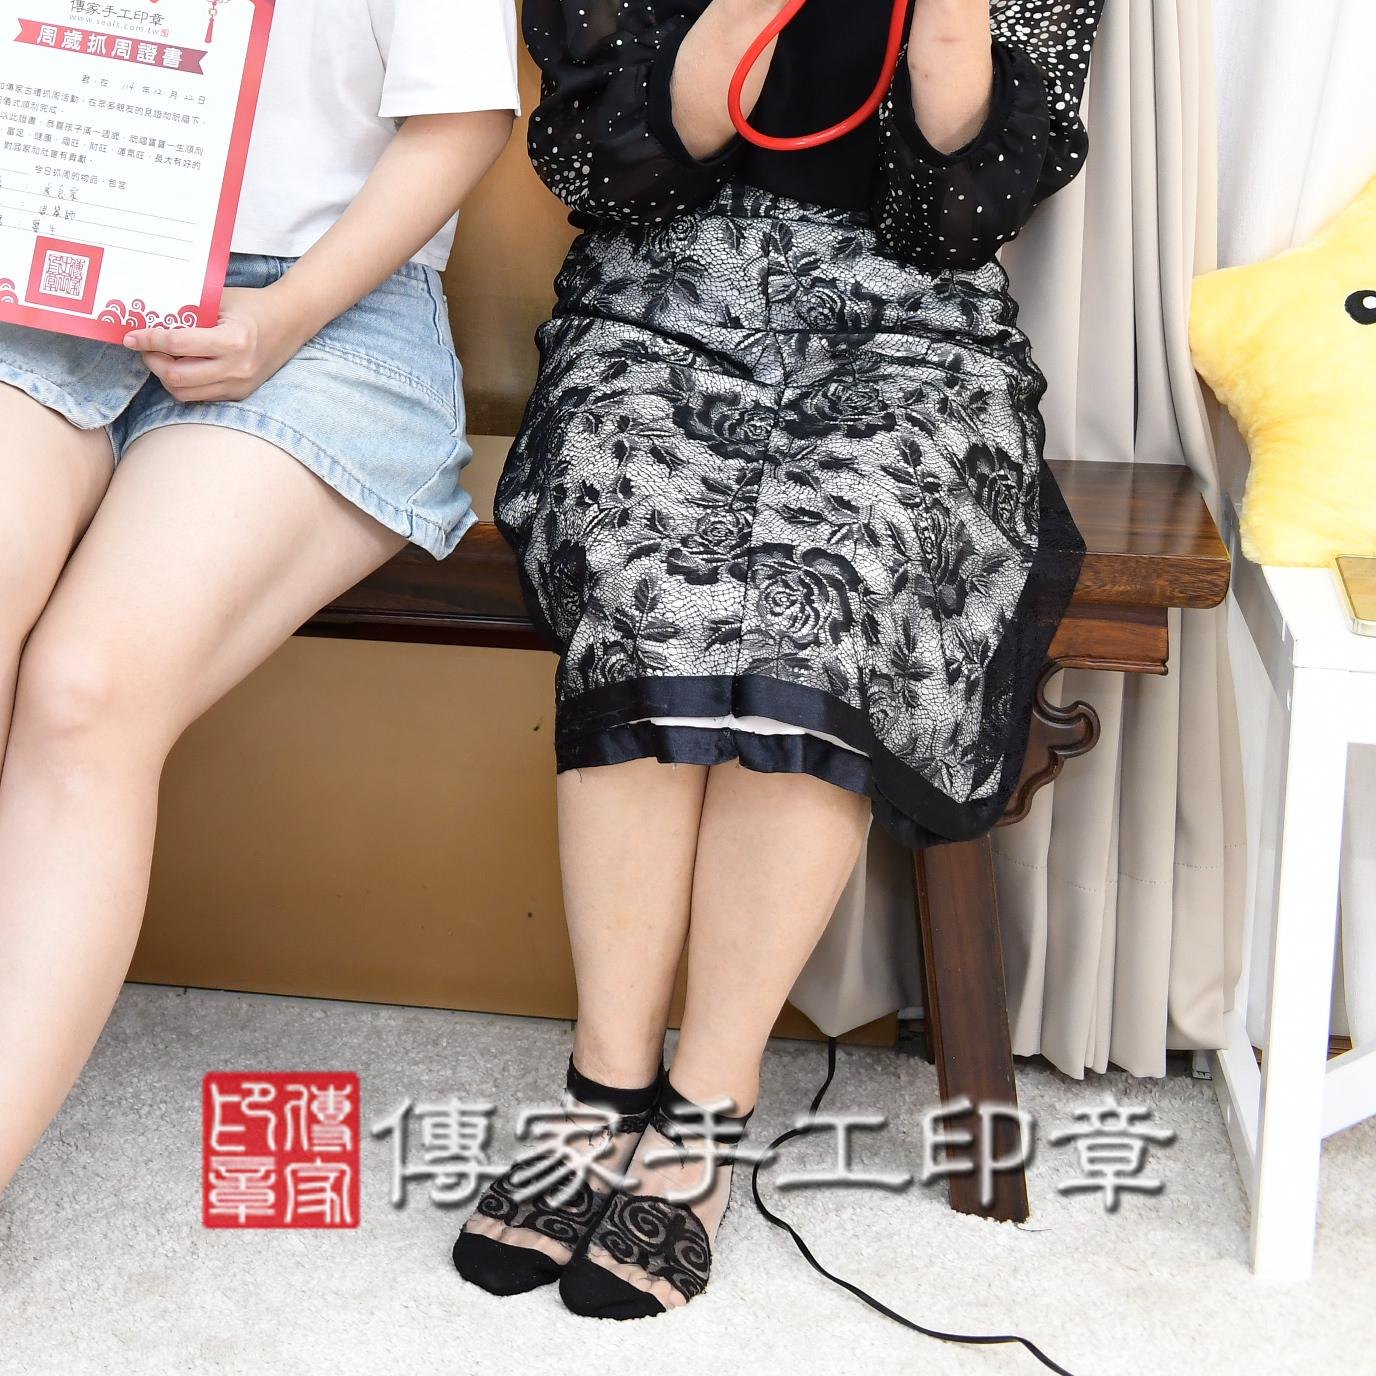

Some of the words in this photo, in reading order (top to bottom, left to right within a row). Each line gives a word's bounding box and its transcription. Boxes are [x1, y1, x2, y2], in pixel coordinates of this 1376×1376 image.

[68, 13, 160, 35] www.seals.com.tw
[36, 23, 183, 69] 周歲抓周證書
